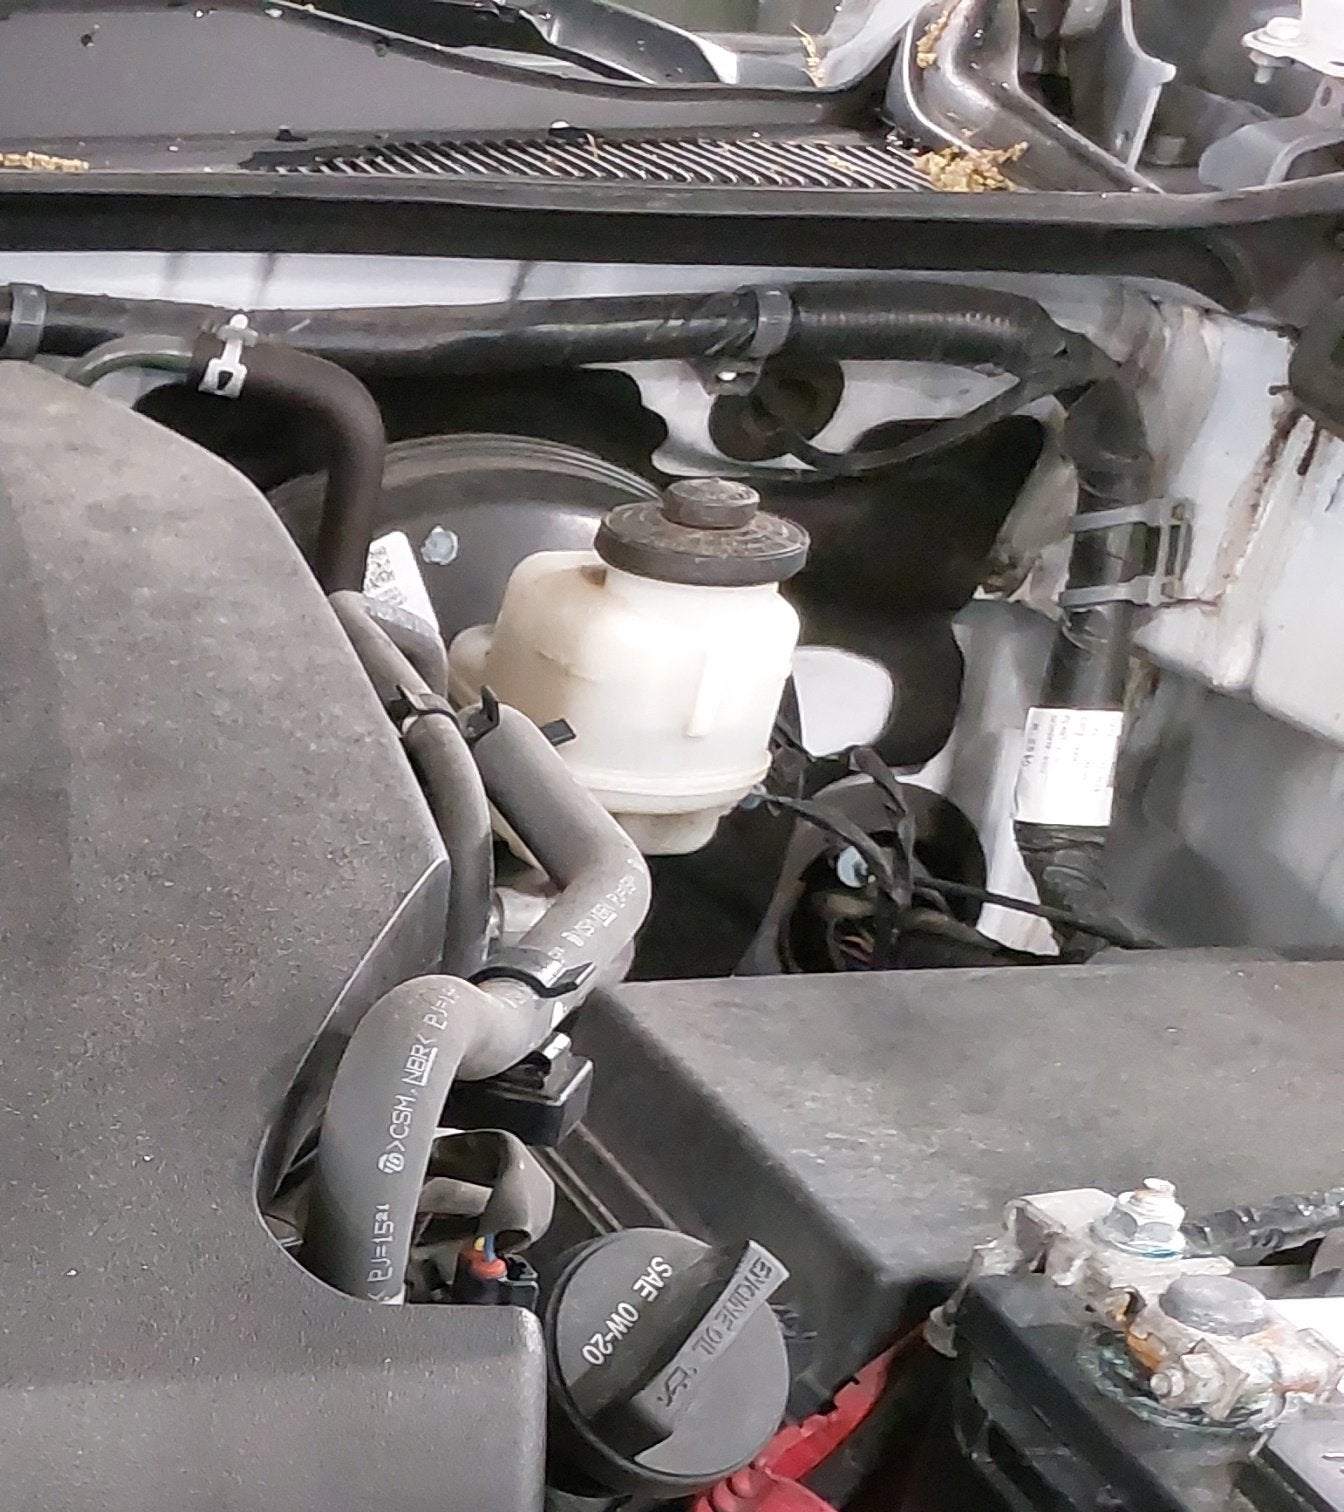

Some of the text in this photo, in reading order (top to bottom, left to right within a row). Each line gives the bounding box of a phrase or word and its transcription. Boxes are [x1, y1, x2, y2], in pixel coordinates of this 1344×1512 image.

[581, 1256, 673, 1366] SAE 0W-20
[691, 1256, 773, 1355] ENGINE OIL
